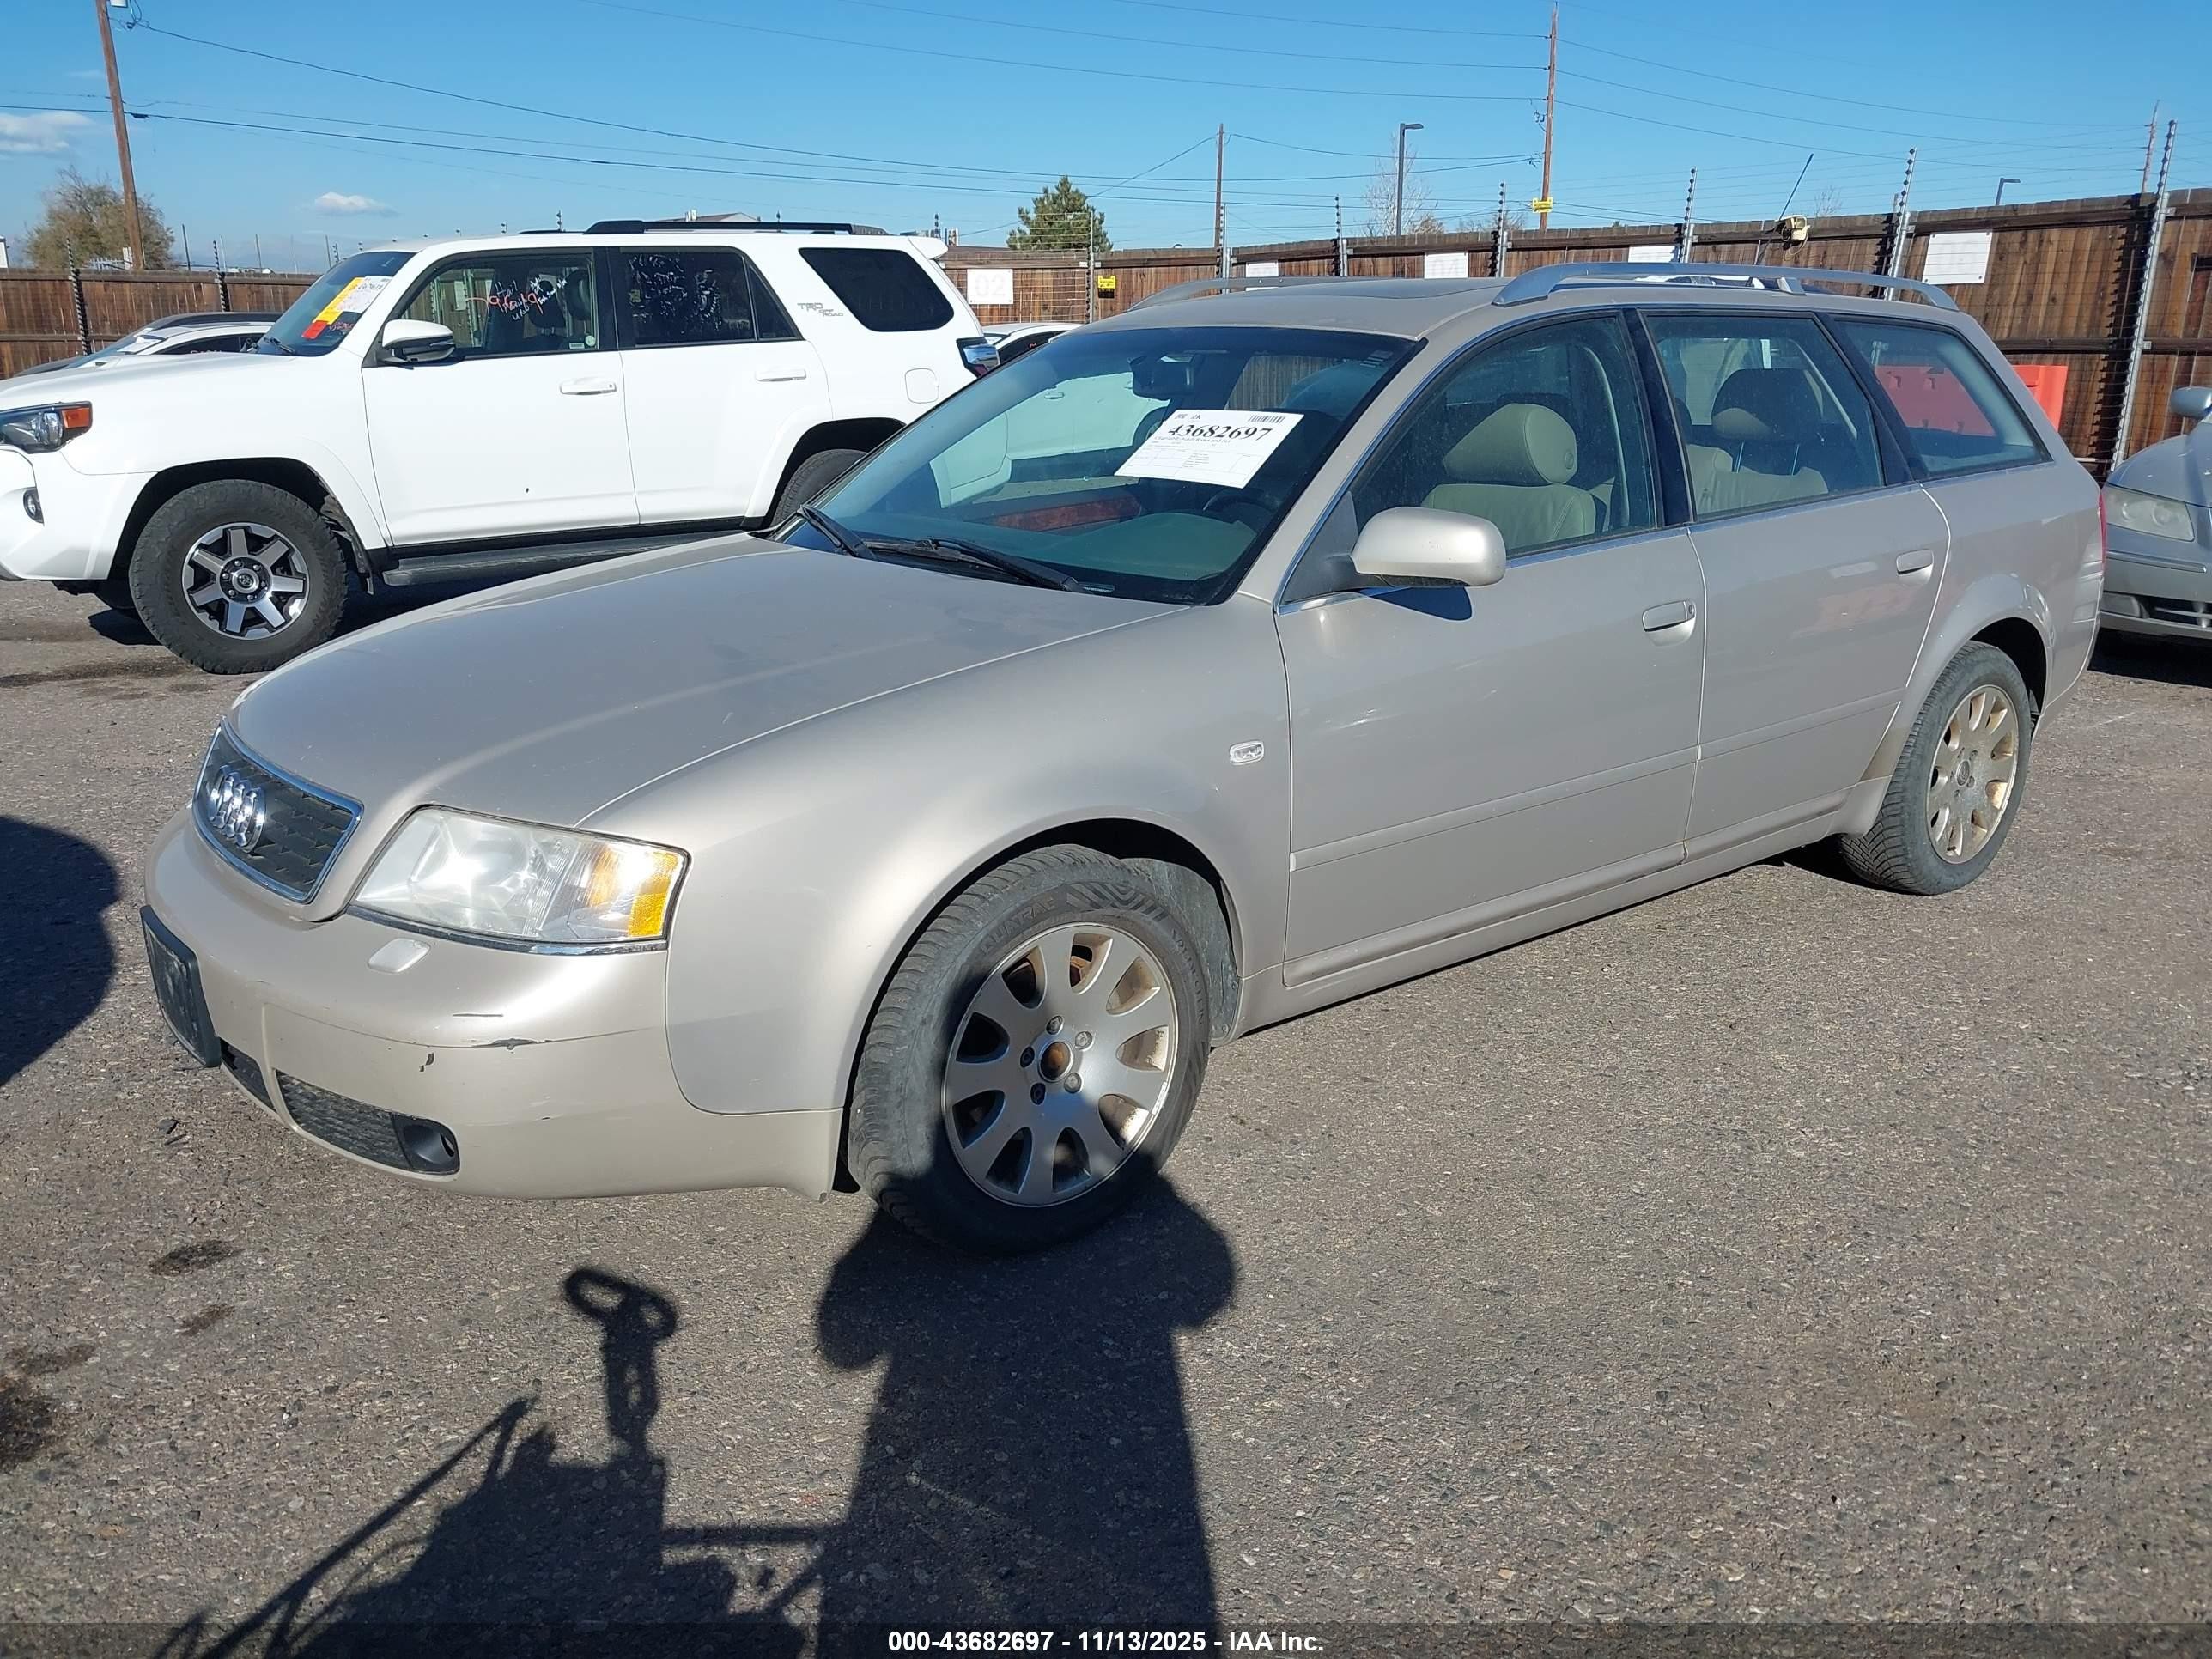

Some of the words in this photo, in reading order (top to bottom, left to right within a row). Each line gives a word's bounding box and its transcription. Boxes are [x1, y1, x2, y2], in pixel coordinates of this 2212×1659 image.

[975, 273, 1006, 297] 02
[797, 302, 823, 312] TRD
[1168, 423, 1273, 441] 43682697
